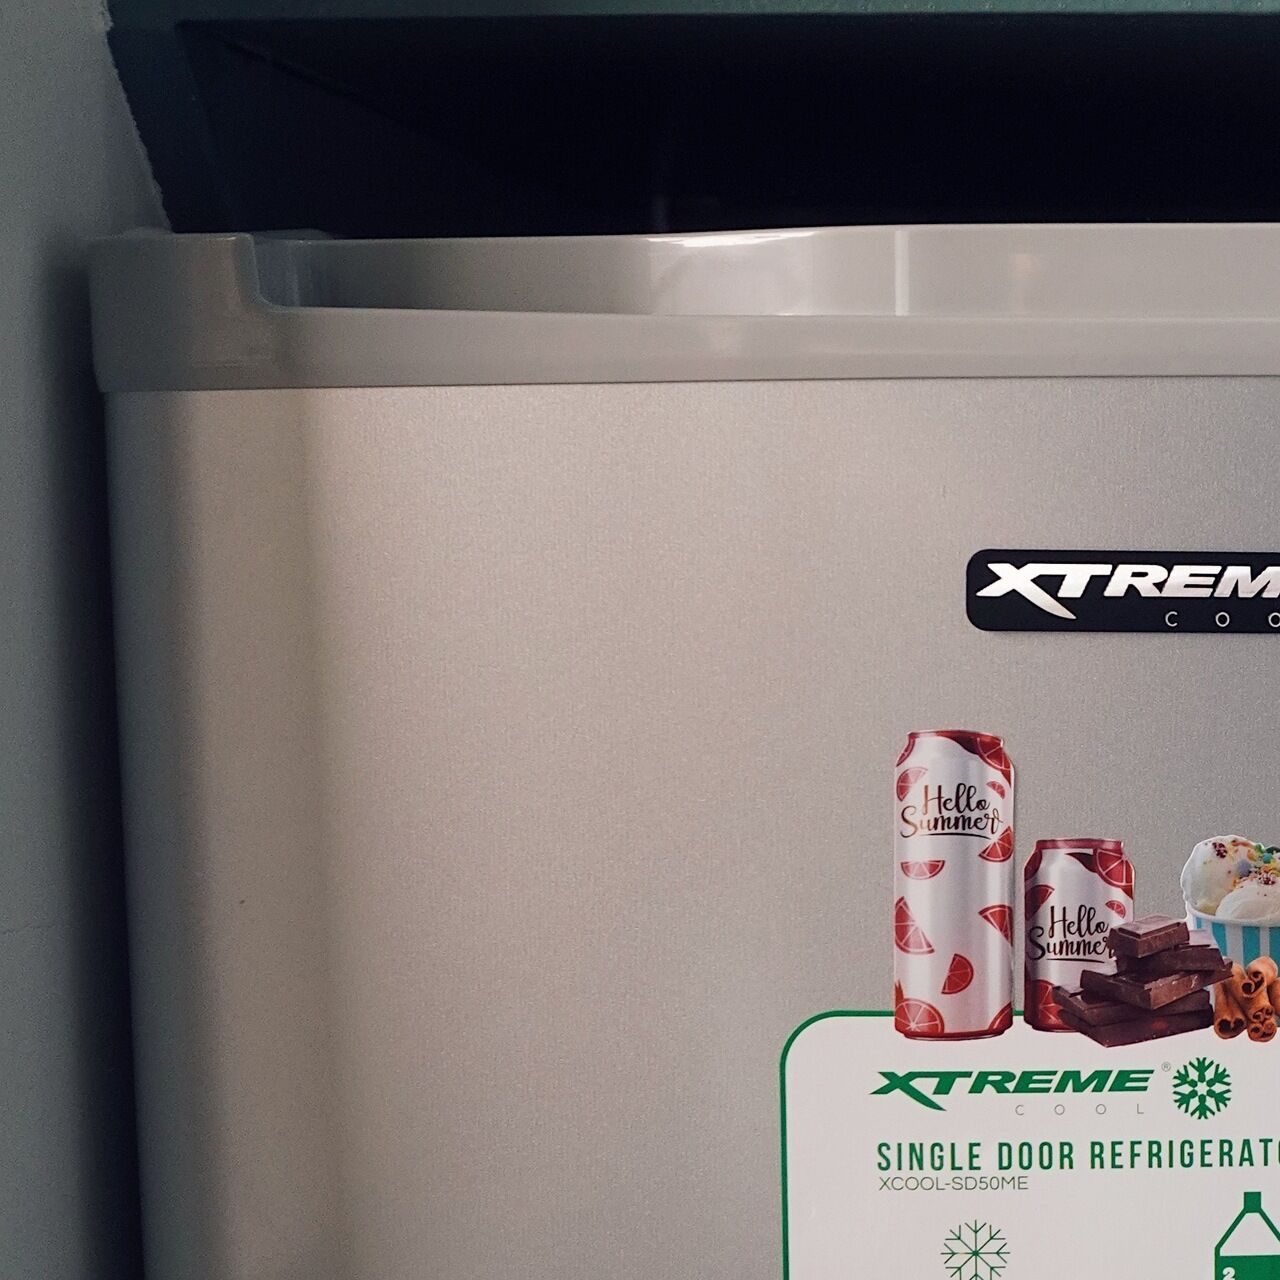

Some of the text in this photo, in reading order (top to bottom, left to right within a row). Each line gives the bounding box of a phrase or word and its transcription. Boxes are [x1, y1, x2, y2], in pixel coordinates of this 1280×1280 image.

[923, 782, 991, 815] Hello
[900, 805, 1003, 838] Summer
[1049, 904, 1110, 939] Hello
[1027, 926, 1116, 960] Summer
[869, 1068, 1156, 1112] XTREME
[876, 1141, 983, 1172] SINGLE
[997, 1140, 1075, 1171] DOOR
[878, 1175, 1029, 1192] XCOOL-SD50ME
